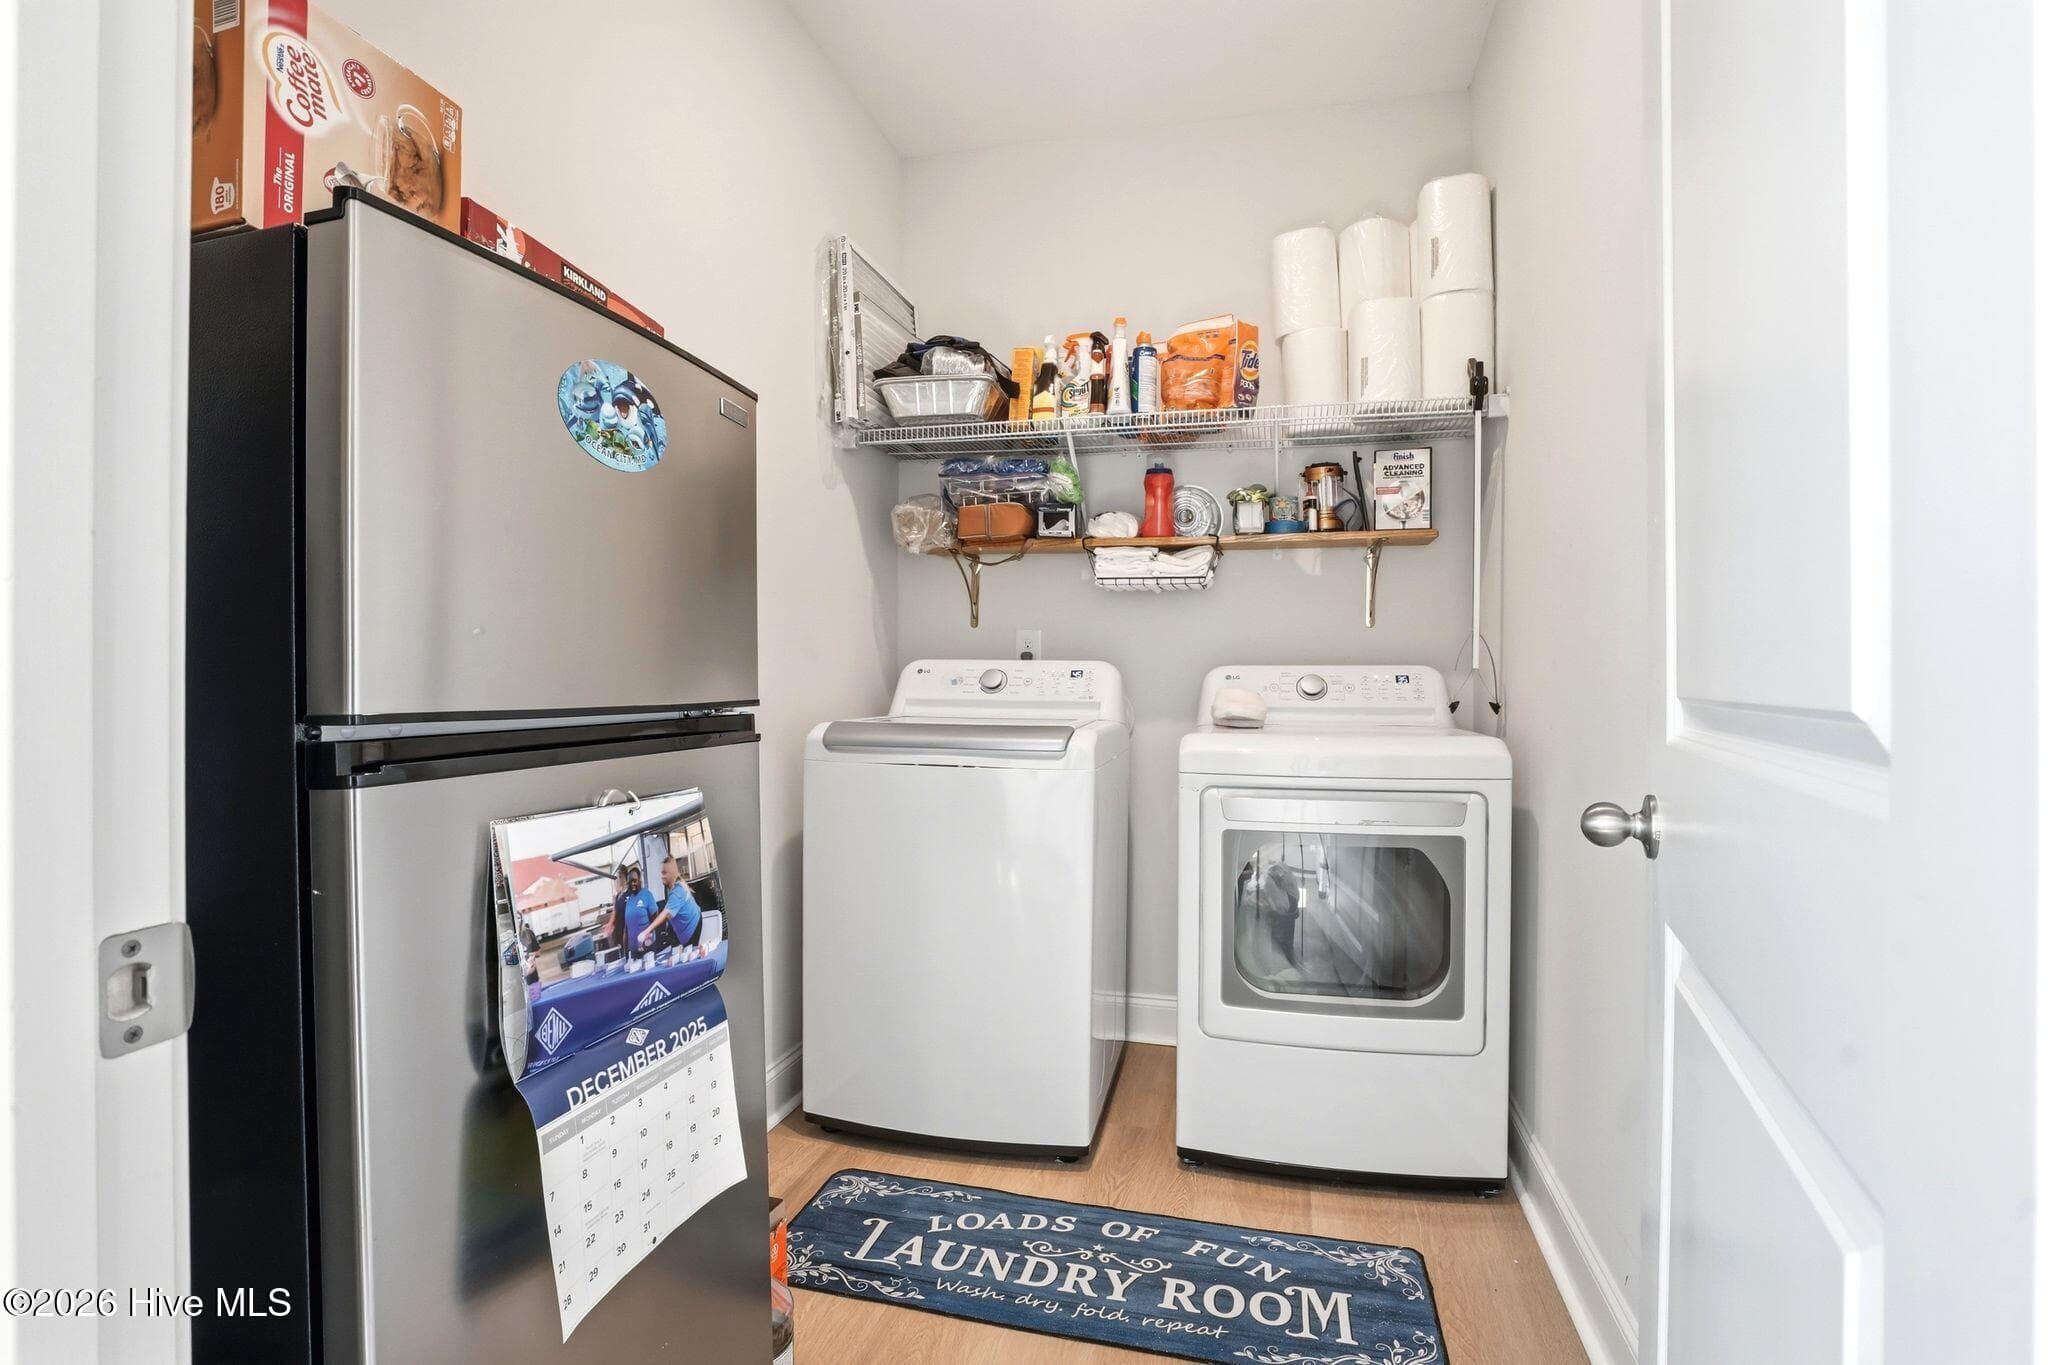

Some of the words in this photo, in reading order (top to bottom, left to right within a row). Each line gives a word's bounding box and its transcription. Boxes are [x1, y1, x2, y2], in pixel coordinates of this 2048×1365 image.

[286, 45, 314, 127] Coffee
[307, 51, 327, 120] mate
[214, 186, 225, 210] 180
[273, 166, 283, 186] The
[283, 153, 295, 213] ORIGINAL
[563, 266, 606, 301] KIRKLAND
[1241, 350, 1259, 369] Tide
[585, 434, 615, 459] OCEAN
[1383, 463, 1425, 471] ADVANCED
[1384, 469, 1423, 477] CLEANING
[566, 1039, 668, 1111] DECEMBER
[669, 1016, 707, 1051] 2025
[581, 1136, 584, 1144] 1
[610, 1116, 615, 1125] 2
[638, 1099, 642, 1108] 3
[664, 1082, 668, 1090] 4
[550, 1192, 554, 1202] 7
[582, 1169, 587, 1179] 8
[612, 1149, 617, 1158] 9
[640, 1128, 647, 1138] 10
[666, 1112, 671, 1120] 11
[689, 1095, 695, 1104] 12
[584, 1201, 593, 1213] 15
[614, 1179, 622, 1190] 16
[640, 1159, 648, 1170] 17
[666, 1141, 673, 1150] 18
[690, 1124, 696, 1133] 19
[712, 1107, 720, 1118] 20
[559, 1261, 565, 1274] 21
[586, 1234, 596, 1248] 22
[615, 1210, 624, 1224] 23
[714, 1135, 722, 1146] 27
[589, 1267, 598, 1282] 29
[616, 1242, 626, 1256] 30
[643, 1221, 650, 1232] 31
[926, 1212, 1078, 1234] LOADS
[1100, 1220, 1161, 1243] OF
[1181, 1239, 1292, 1283] FUN
[844, 1217, 1143, 1302] LAUNDRY
[1157, 1276, 1360, 1346] ROOM
[1141, 1313, 1230, 1339] repeat
